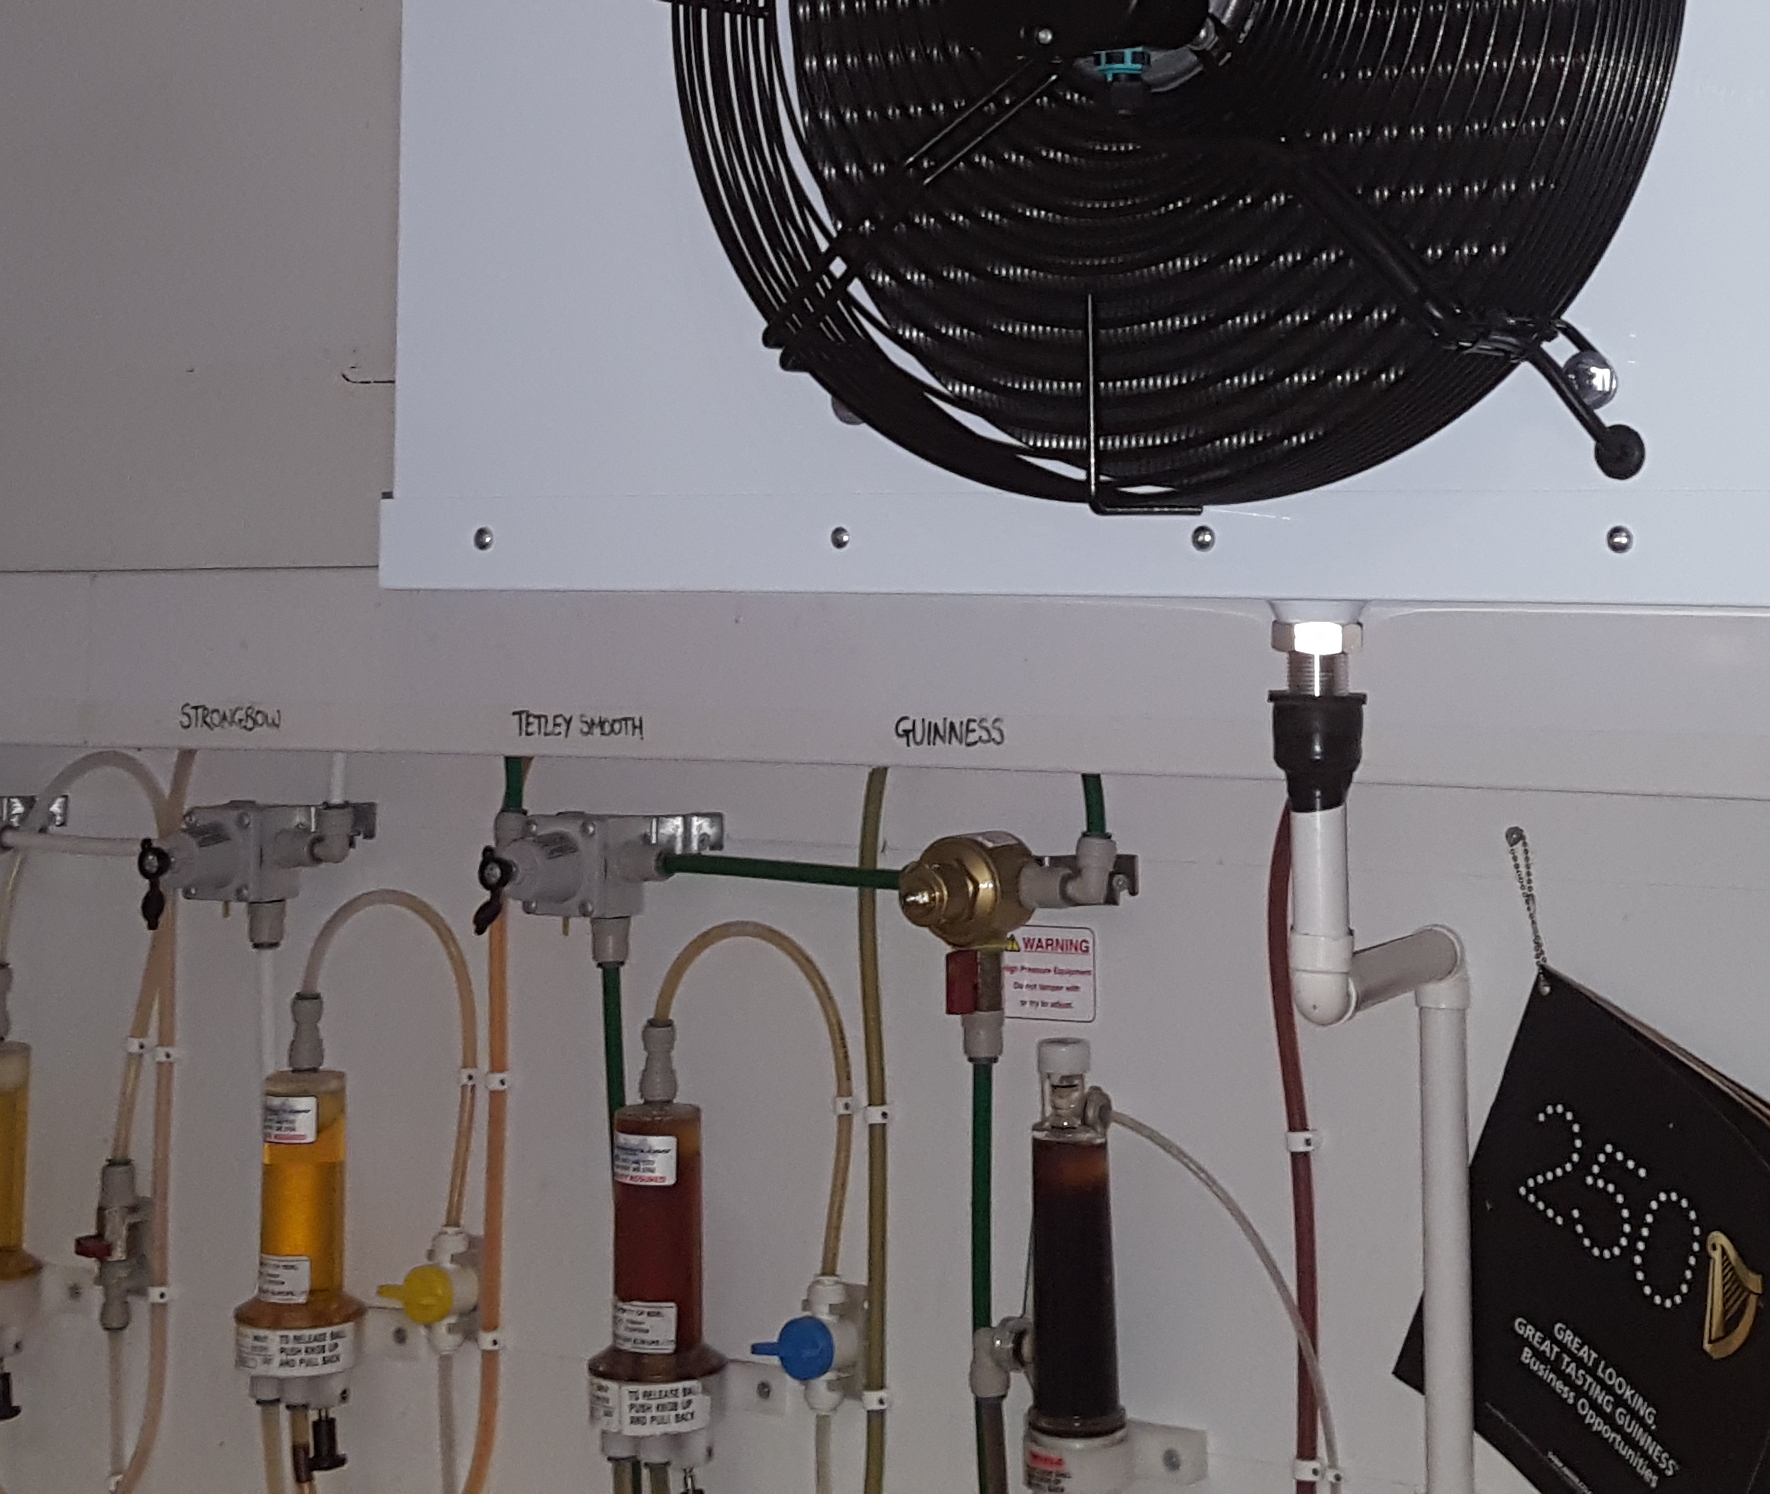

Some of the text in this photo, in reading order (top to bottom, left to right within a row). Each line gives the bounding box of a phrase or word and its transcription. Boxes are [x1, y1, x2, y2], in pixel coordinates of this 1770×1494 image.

[179, 702, 283, 731] STRONGBOW
[511, 709, 646, 742] TETLEY SMOOTH
[893, 714, 1006, 748] GUINNESS
[1022, 936, 1090, 954] WARNING
[1518, 1103, 1703, 1309] 250
[1513, 1317, 1561, 1362] GREAT
[1559, 1353, 1615, 1414] TASTING
[1614, 1406, 1680, 1478] GUINNESS
[1553, 1321, 1658, 1431] GREAT LOOKING,
[1519, 1346, 1577, 1406] Business
[1575, 1397, 1660, 1490] Opportunities
